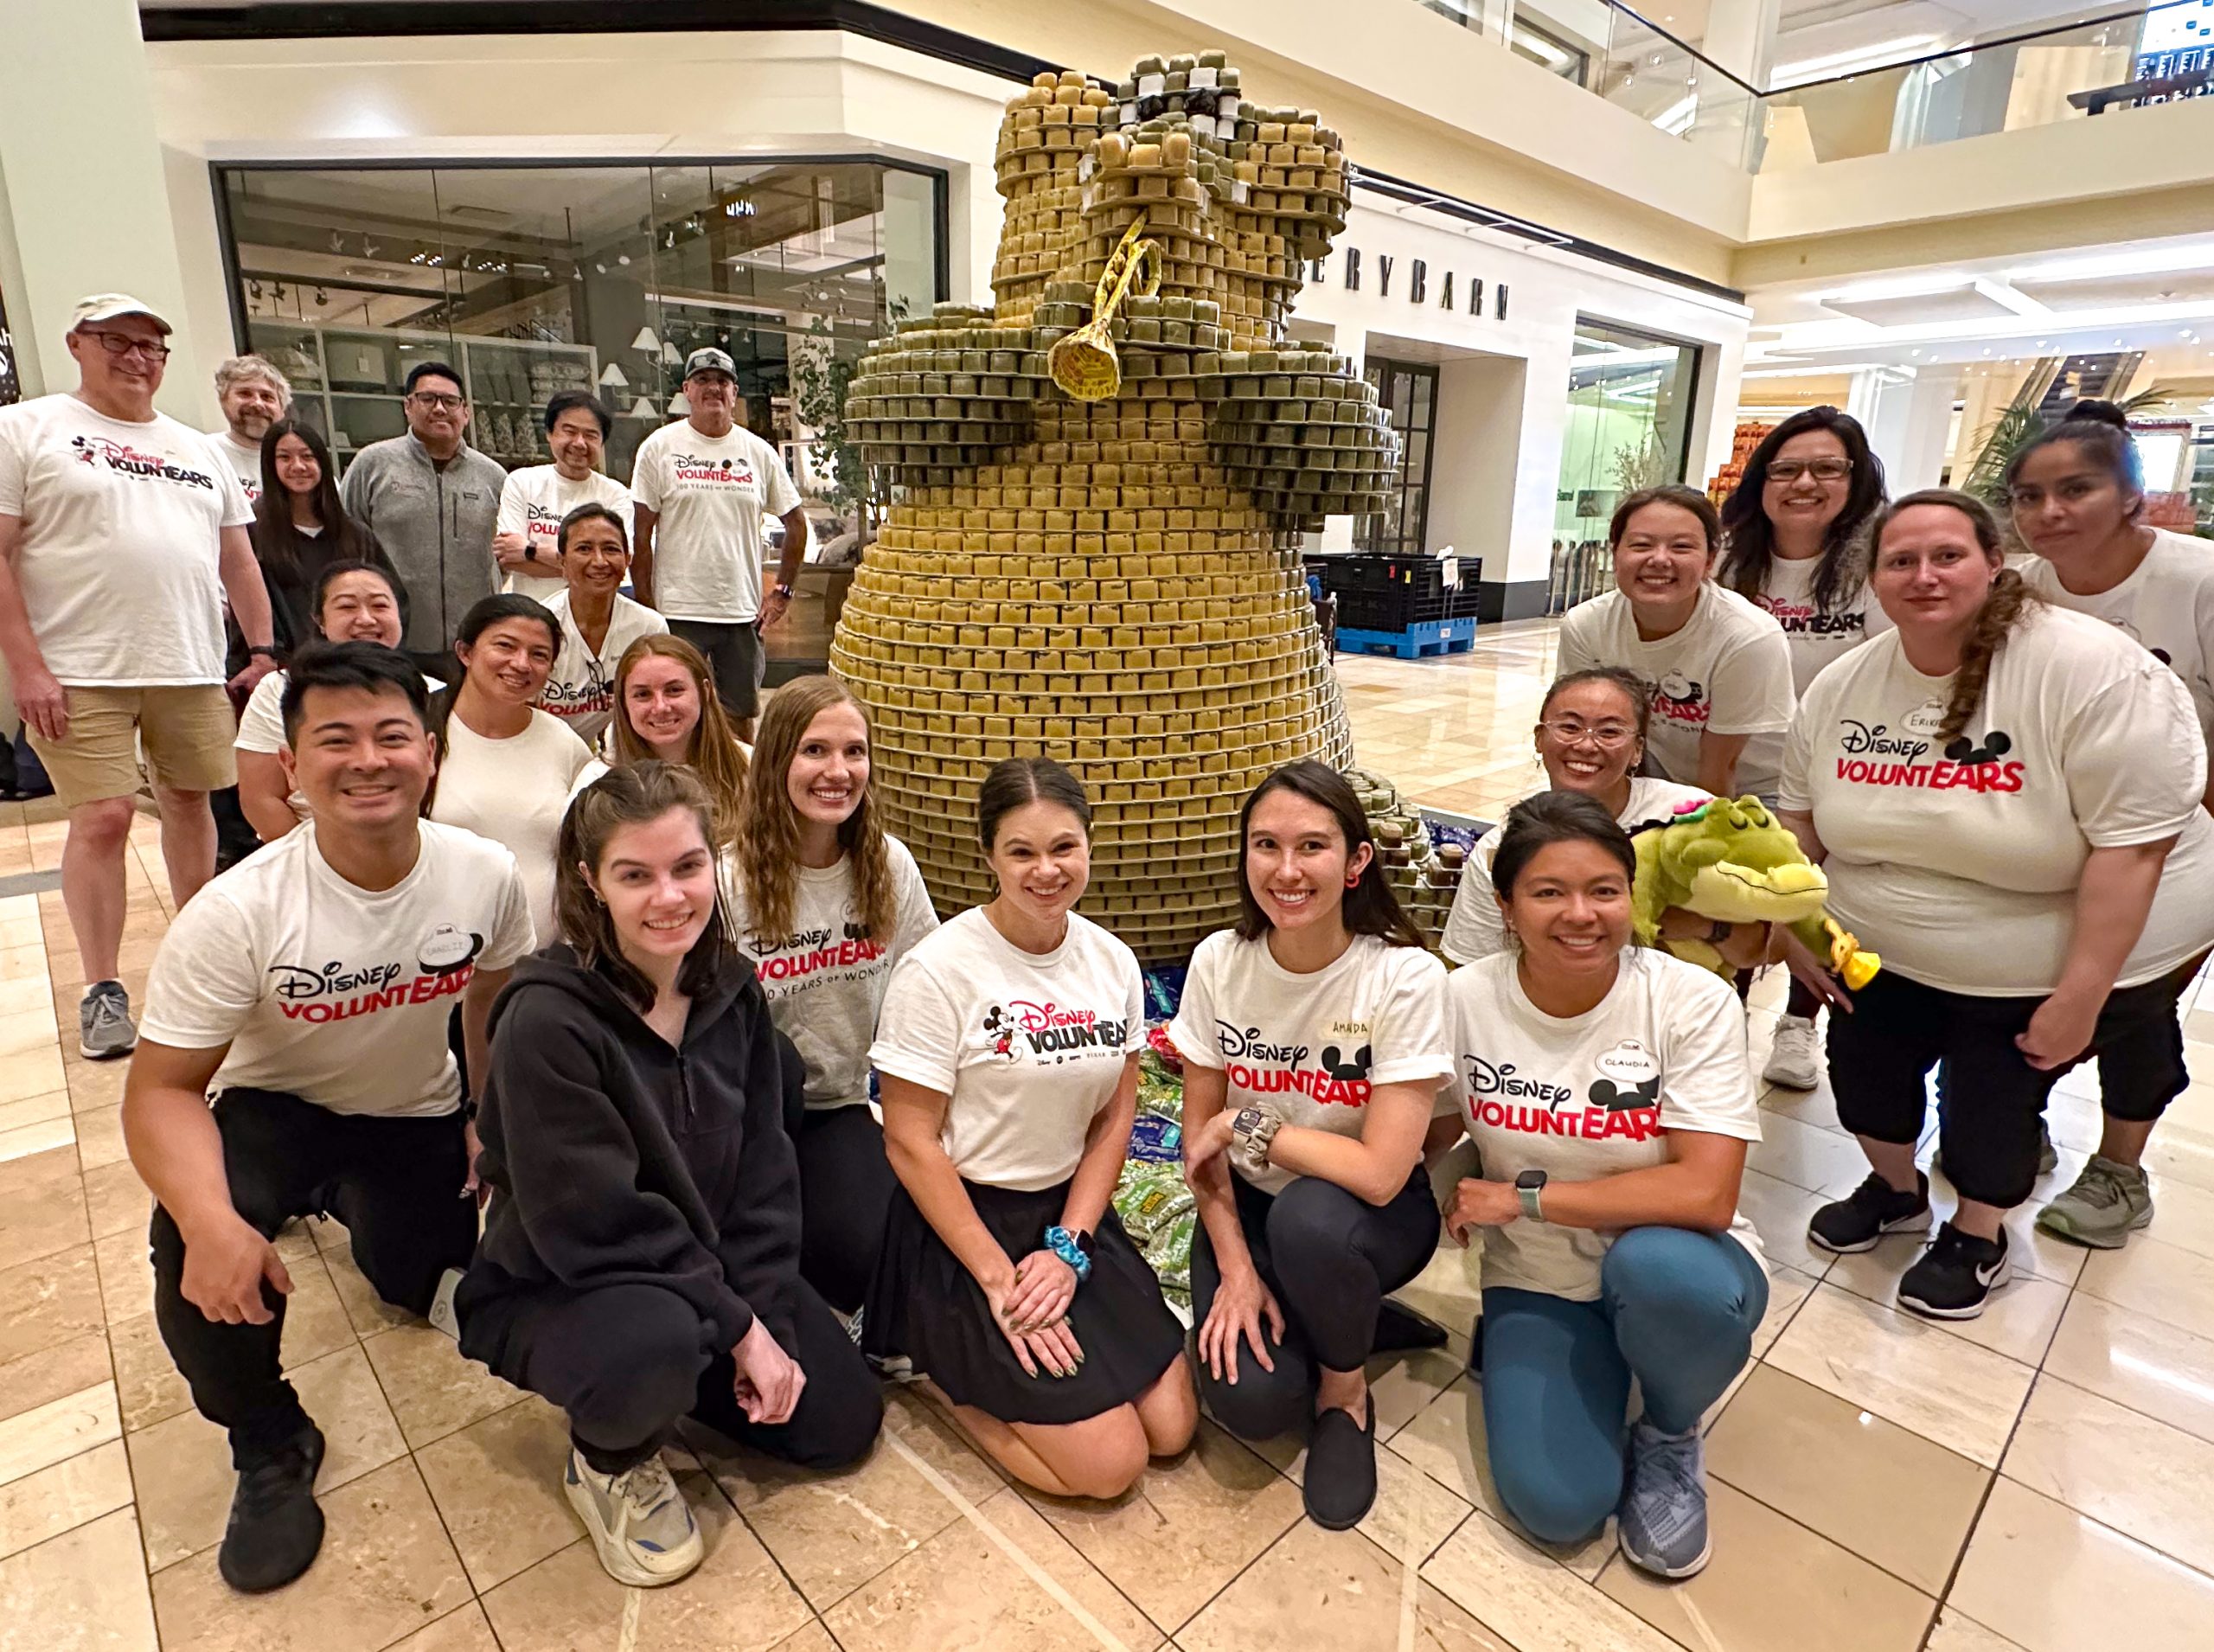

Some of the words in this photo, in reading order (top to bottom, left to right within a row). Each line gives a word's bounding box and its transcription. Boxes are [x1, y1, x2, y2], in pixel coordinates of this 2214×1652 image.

[92, 437, 164, 469] Disney
[671, 454, 716, 471] Disney
[105, 456, 213, 490] VOLUNTEARS
[724, 484, 754, 493] WONDER
[528, 503, 564, 523] Disne
[1910, 714, 1939, 727] ERIK
[1840, 720, 1928, 767] Disney
[1837, 758, 2025, 793] VOLUNTEARS
[753, 940, 886, 983] VOLUNTEAR
[781, 976, 822, 996] YEARS
[844, 958, 890, 982] WONDR
[268, 961, 401, 999] Disney
[278, 964, 475, 1023] VOLUNTEAR
[1008, 1000, 1096, 1034] Disney
[1025, 1019, 1127, 1054] VOLUNTEA
[1215, 1019, 1309, 1073] Disney
[1604, 1058, 1650, 1068] CLAUDIA
[1225, 1062, 1373, 1108] VOLUNTEAR
[1463, 1054, 1571, 1114] Disney
